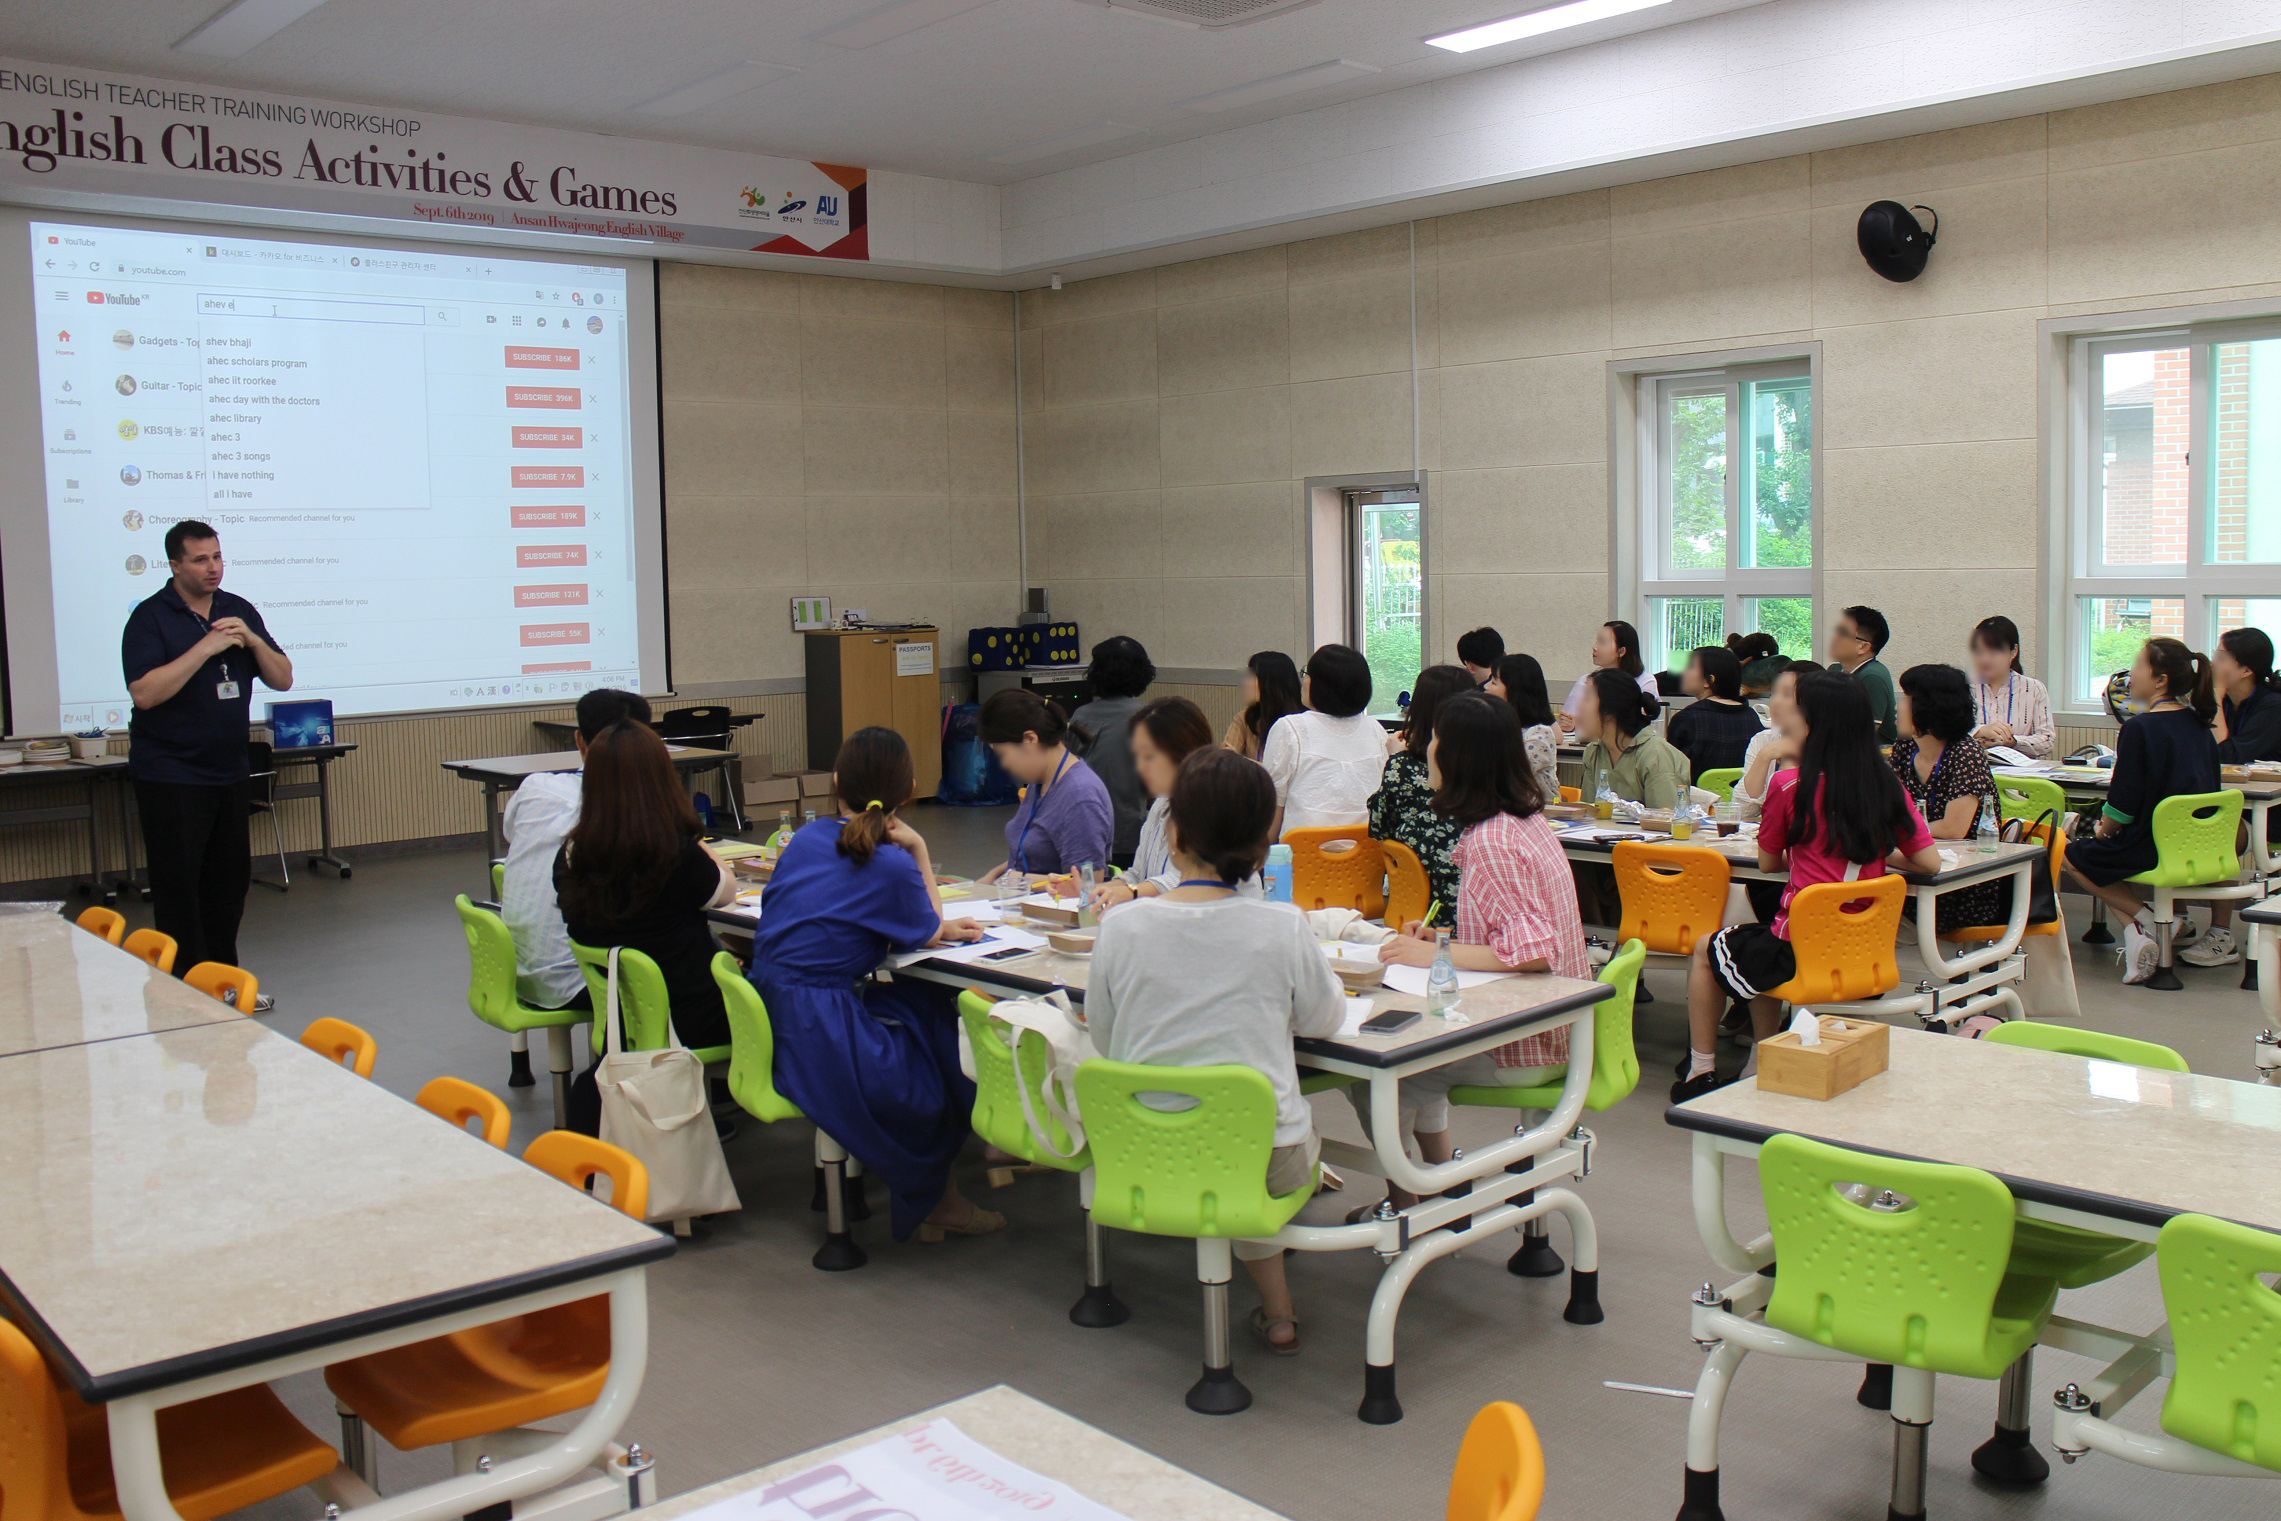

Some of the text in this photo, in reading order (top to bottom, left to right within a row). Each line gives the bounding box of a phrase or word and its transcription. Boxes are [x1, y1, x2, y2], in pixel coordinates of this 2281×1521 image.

[0, 70, 421, 137] ENGLISH TEACHER TRAINING WORKSHOP
[161, 123, 283, 177] Class
[293, 138, 492, 198] Activities
[503, 161, 539, 203] &
[550, 166, 678, 216] Games
[816, 195, 838, 216] AU
[413, 203, 444, 220] Sept.
[467, 212, 495, 225] 2019
[510, 212, 685, 242] Ansan Hwajeong English Village
[64, 238, 96, 247] YouTube
[260, 251, 282, 260] 카카오
[283, 253, 294, 261] for
[295, 254, 325, 263] 비즈니스
[400, 261, 421, 270] 관리자
[423, 263, 437, 271] 센터
[131, 266, 187, 277] youtube.com
[105, 292, 141, 306] YouTube
[204, 300, 226, 309] ahev
[139, 335, 178, 348] Gadgets
[206, 338, 252, 349] shev bhaji
[207, 357, 308, 369] ahec scholars program
[512, 353, 573, 363] SUBSCRIBE 186K
[141, 380, 170, 391] Guitar
[177, 381, 202, 392] Topic
[208, 376, 230, 384] ahec
[243, 377, 277, 386] roorkee
[54, 398, 82, 407] Trending
[209, 395, 321, 406] ahec day with the doctors
[514, 393, 574, 403] SUBSCRIBE 396K
[210, 414, 262, 425] ahec library
[211, 432, 241, 442] ahec 3
[520, 433, 559, 441] SUBSCRIBE
[49, 447, 92, 455] Subscriptions
[211, 451, 271, 462] ahec 3 songs
[146, 470, 184, 480] Thomas
[185, 470, 194, 480] &
[218, 471, 239, 480] have
[241, 470, 275, 481] nothing
[519, 473, 558, 481] SUBSCRIBE
[213, 489, 225, 498] all
[231, 489, 253, 498] have
[63, 497, 85, 505] Library
[220, 515, 245, 526] Topic
[249, 514, 302, 523] Recommended
[303, 514, 331, 522] channel
[331, 514, 341, 522] for
[342, 516, 356, 524] you
[518, 512, 557, 520] SUBSCRIBE
[524, 551, 579, 560] SUBSCRIBE 74K
[231, 558, 286, 567] Recommended
[287, 558, 315, 566] channel
[315, 557, 325, 565] for
[326, 558, 340, 567] you
[522, 591, 581, 600] SUBSCRIBE 121K
[263, 599, 316, 609] Recommended
[317, 598, 344, 606] channel
[345, 598, 355, 606] for
[355, 600, 369, 608] you
[527, 629, 582, 639] SUBSCRIBE 55K
[295, 641, 323, 650] channel
[324, 641, 334, 649] for
[335, 642, 348, 650] you
[898, 645, 932, 653] PASSPORTS
